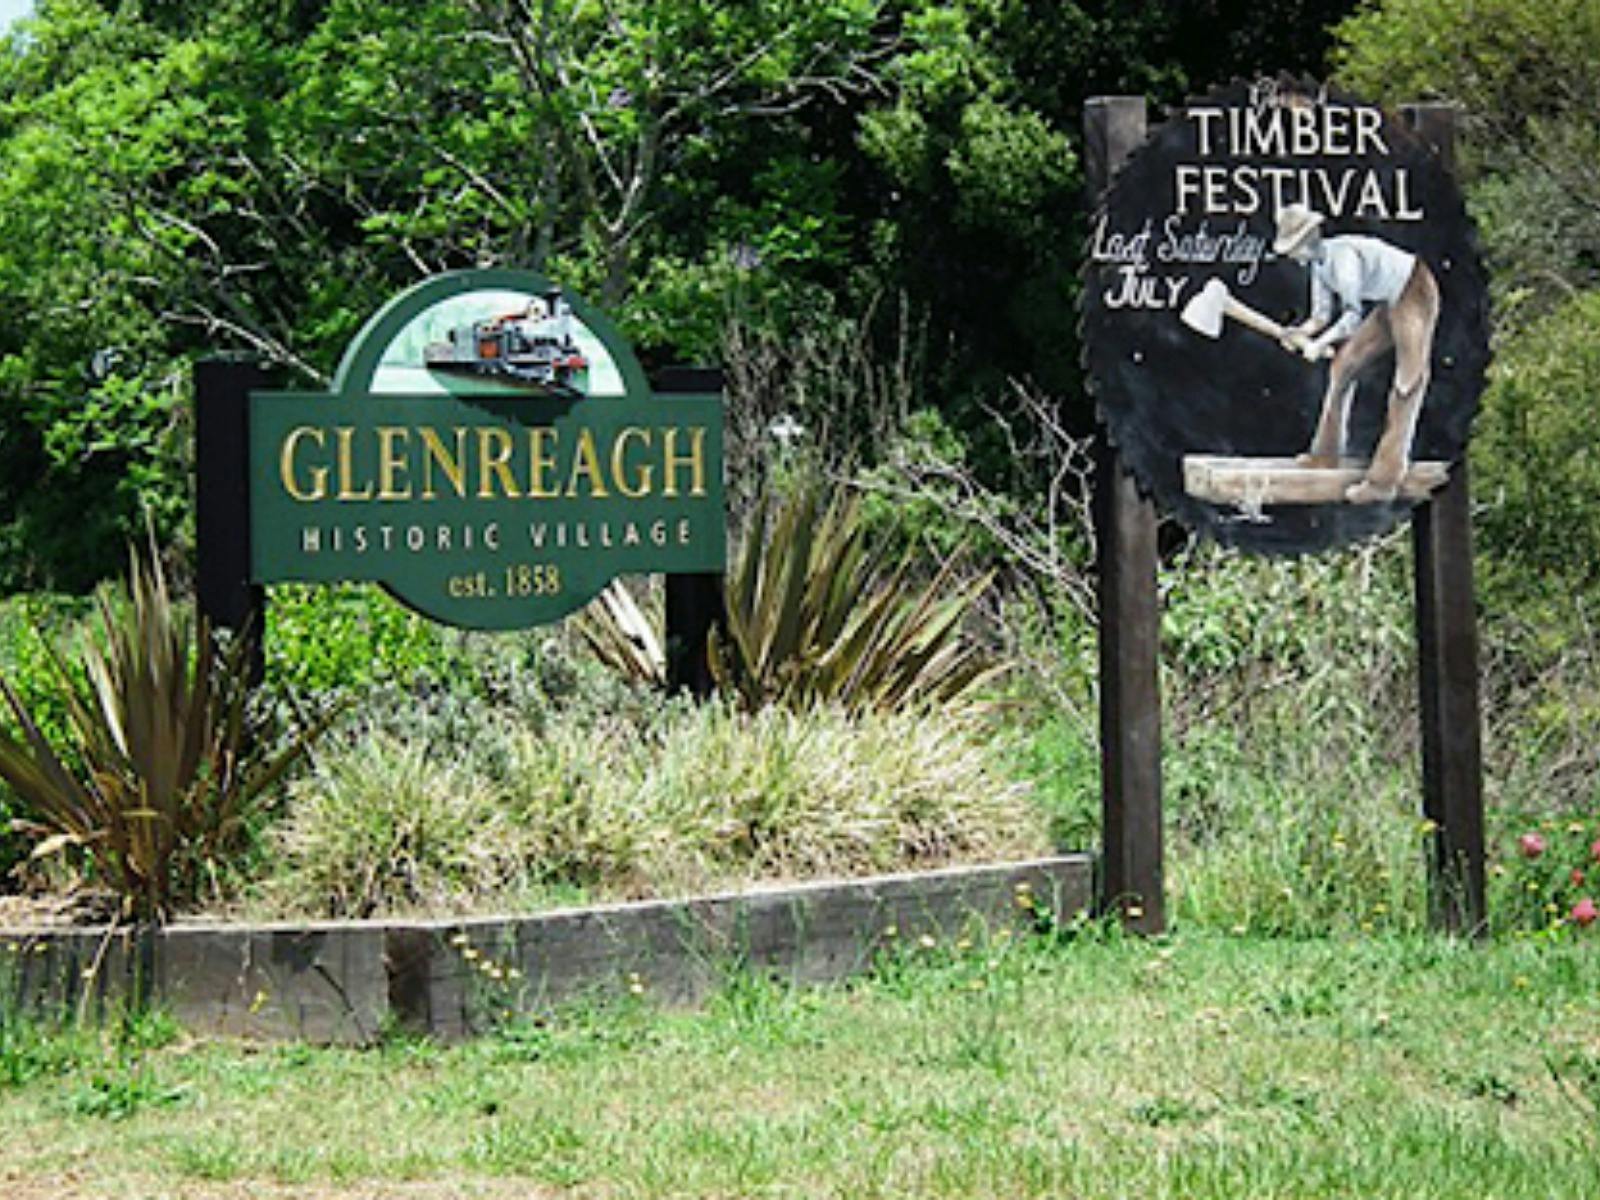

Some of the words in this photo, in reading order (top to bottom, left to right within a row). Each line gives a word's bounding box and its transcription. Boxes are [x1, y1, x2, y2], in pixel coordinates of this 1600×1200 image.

[1187, 106, 1389, 157] TIMBER
[1175, 166, 1424, 221] FESTIVAL
[1104, 264, 1189, 309] JULY
[279, 425, 708, 502] GLENREAGH
[302, 524, 501, 552] HISTORIC
[529, 519, 692, 547] VILLAGE
[448, 570, 497, 598] est.
[505, 564, 561, 597] 1858
